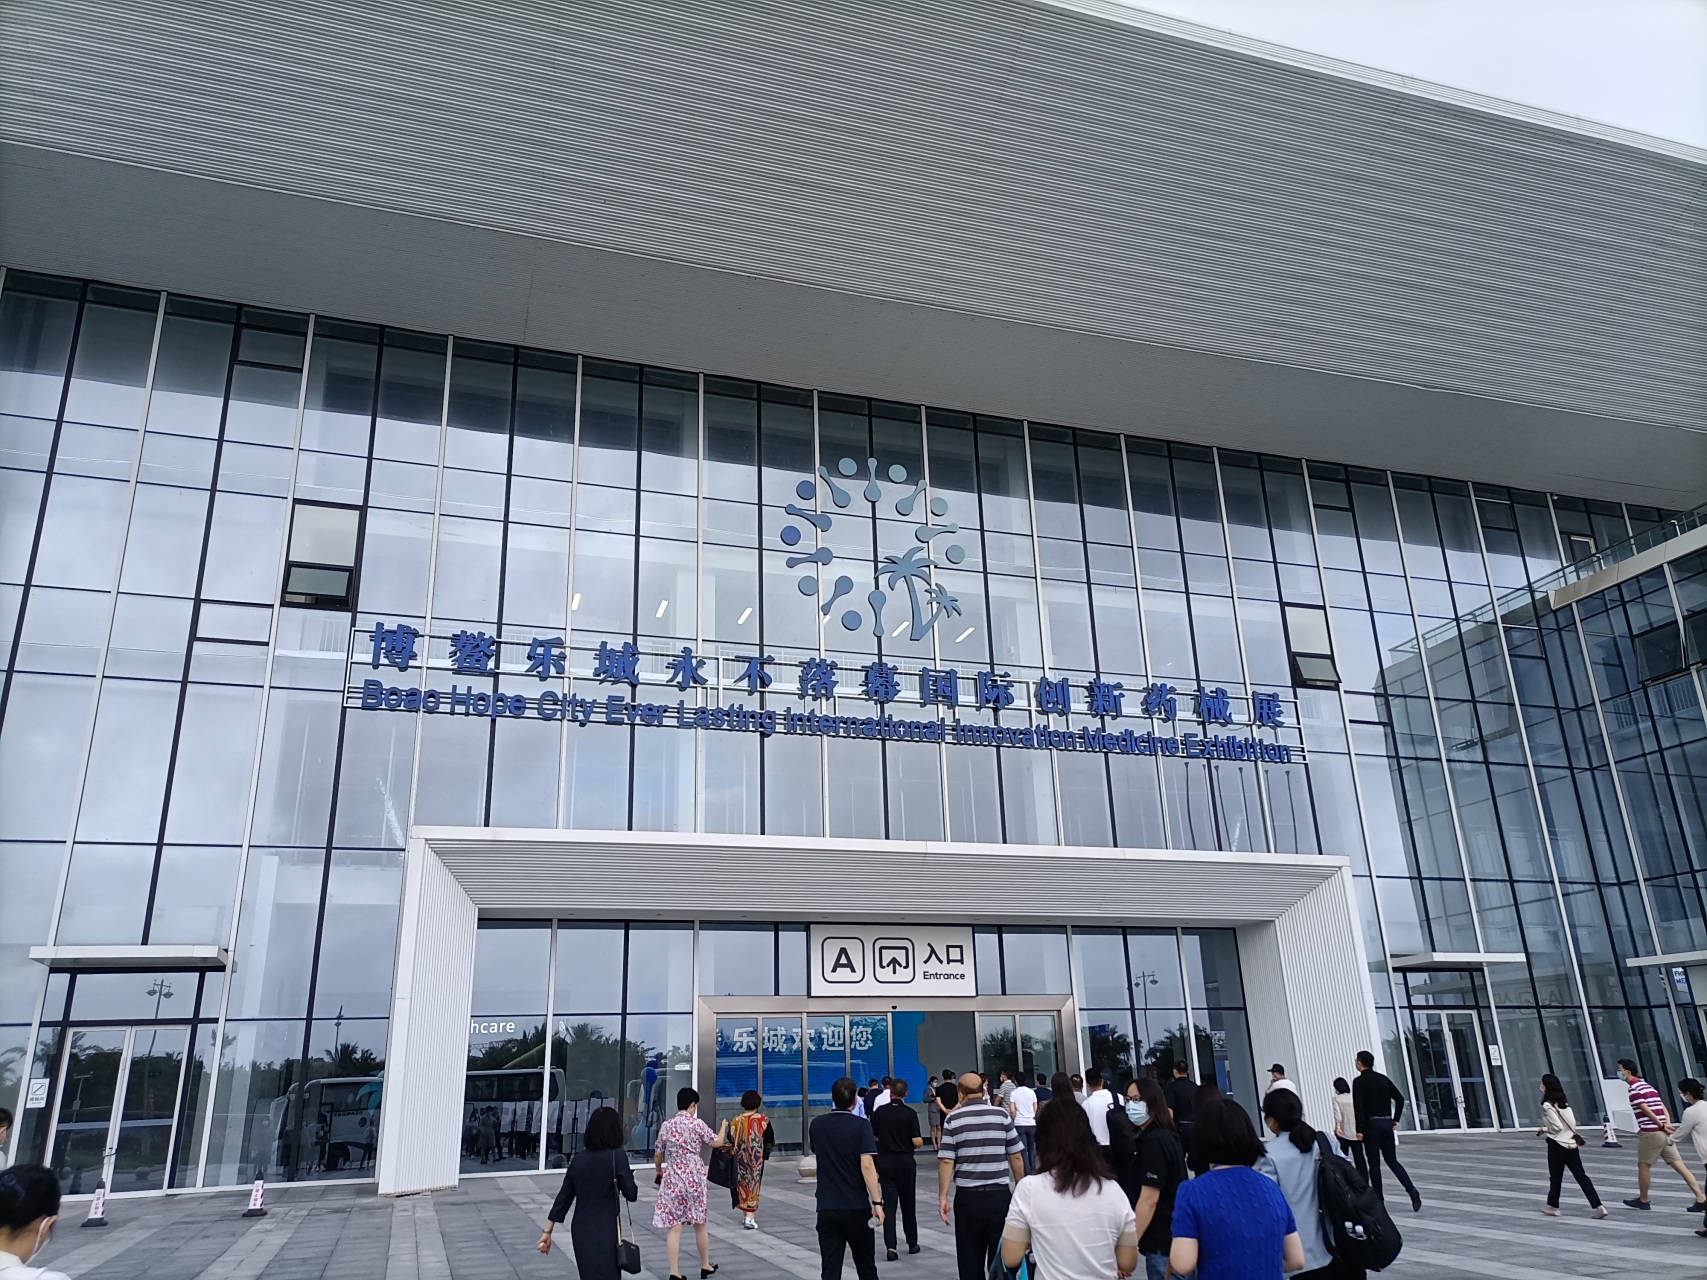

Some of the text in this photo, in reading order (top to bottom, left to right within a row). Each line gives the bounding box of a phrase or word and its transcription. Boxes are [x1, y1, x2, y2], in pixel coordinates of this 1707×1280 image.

[369, 622, 1285, 727] 博鳌乐城永不落幕国际创新药械展
[361, 679, 1292, 763] Boao Hope City Ever Lasting International Innovation Medicine Exhibition
[831, 947, 857, 973] A
[923, 942, 965, 965] 入口
[923, 971, 966, 980] Entrance
[470, 1019, 515, 1034] hcare
[716, 1026, 873, 1052] 乐城欢迎您
